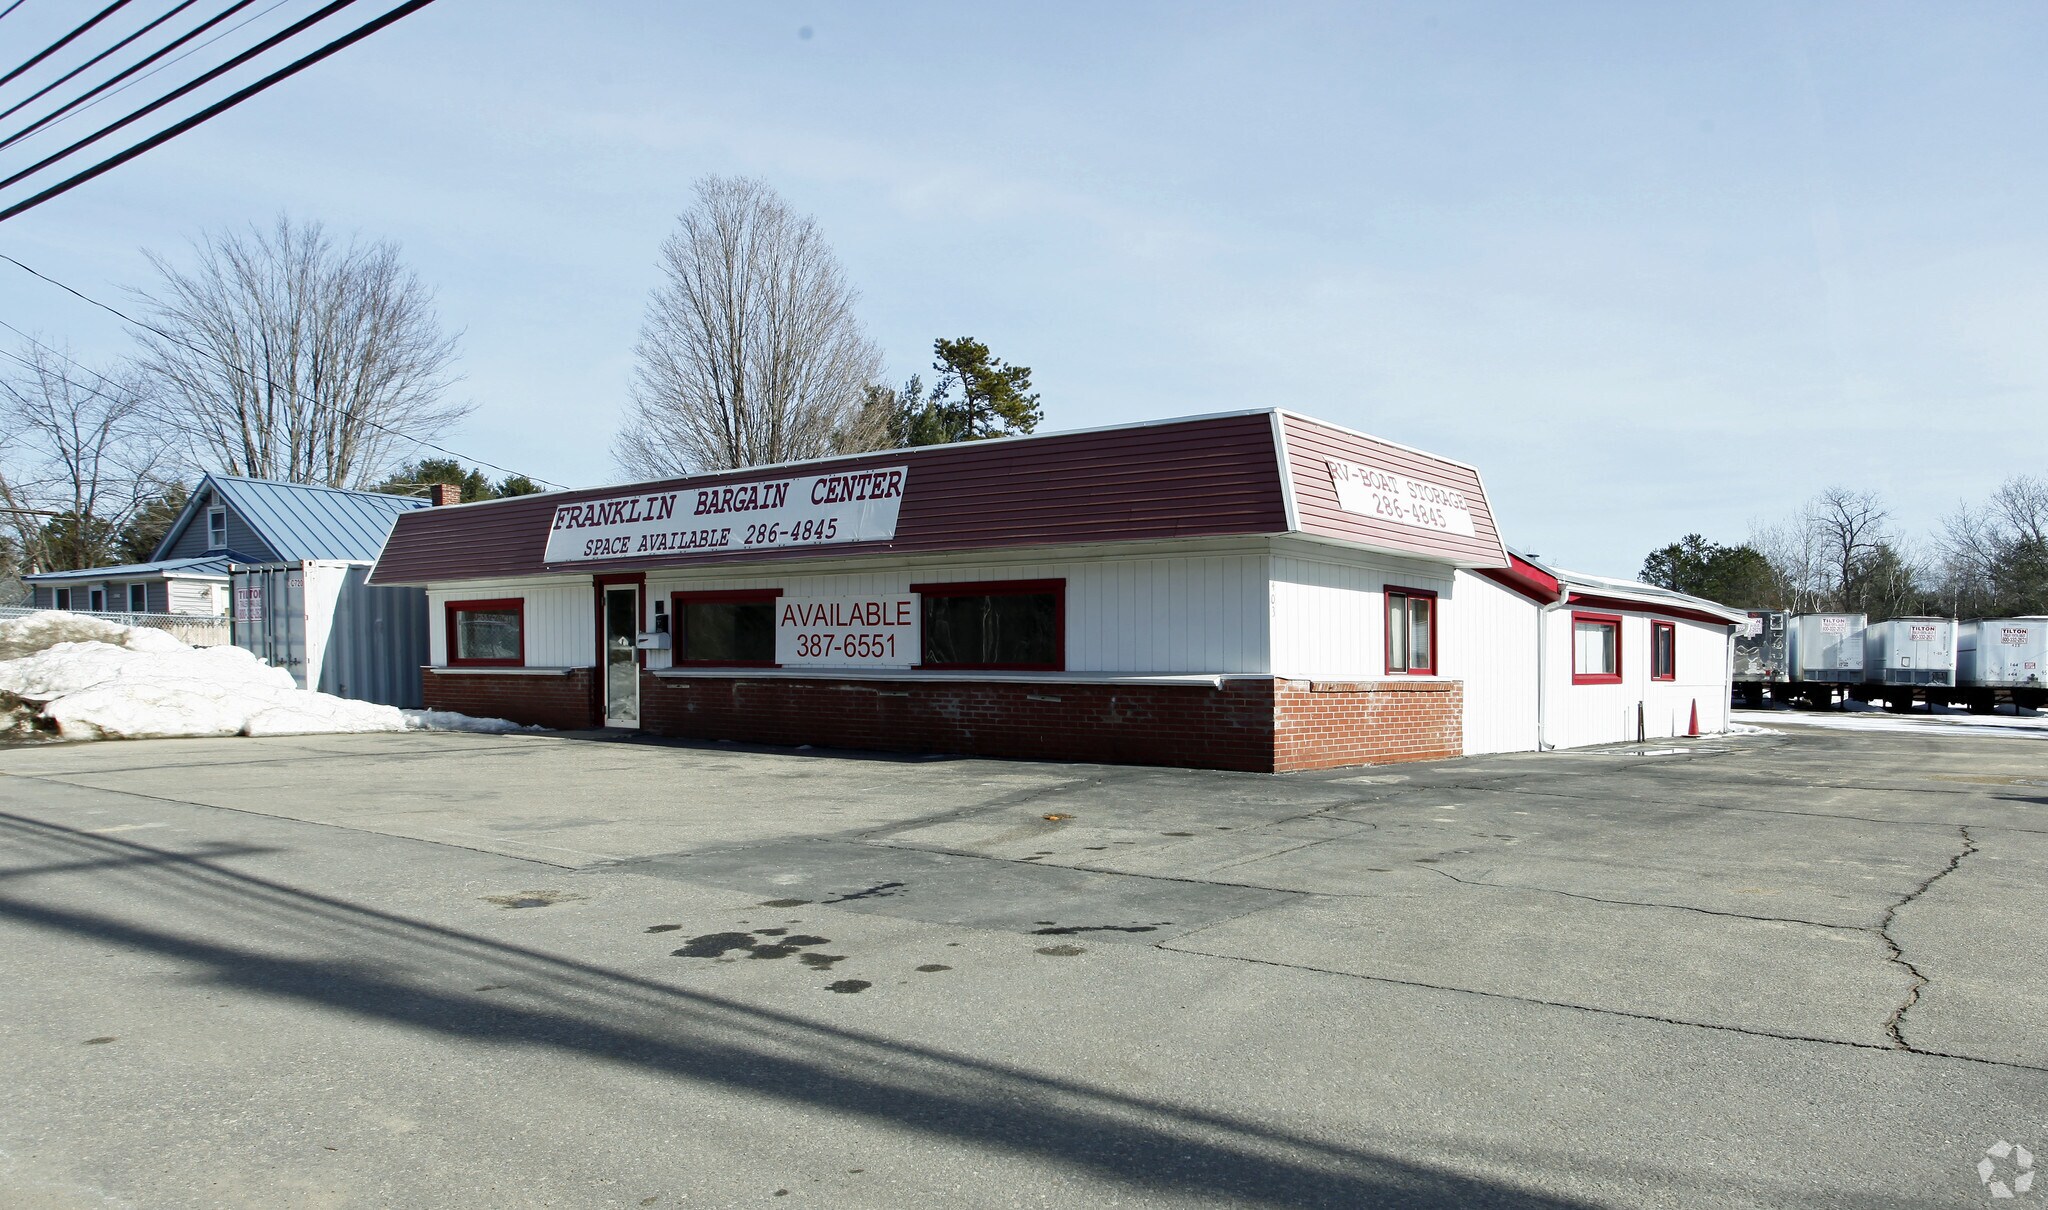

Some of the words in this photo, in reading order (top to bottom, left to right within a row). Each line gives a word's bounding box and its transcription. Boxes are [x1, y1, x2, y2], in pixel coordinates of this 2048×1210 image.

[553, 494, 677, 530] FRANKLIN
[693, 481, 790, 516] BARGAIN
[810, 470, 902, 506] CENTER
[1327, 461, 1399, 494] RV-BOAT
[1406, 481, 1468, 511] STORAGE
[1372, 493, 1447, 529] 286-4845
[583, 539, 629, 558] SPACE
[637, 527, 731, 553] AVAILABLE
[744, 517, 839, 545] 286-4845
[780, 600, 912, 627] AVAILABLE
[796, 633, 896, 660] 387-6551
